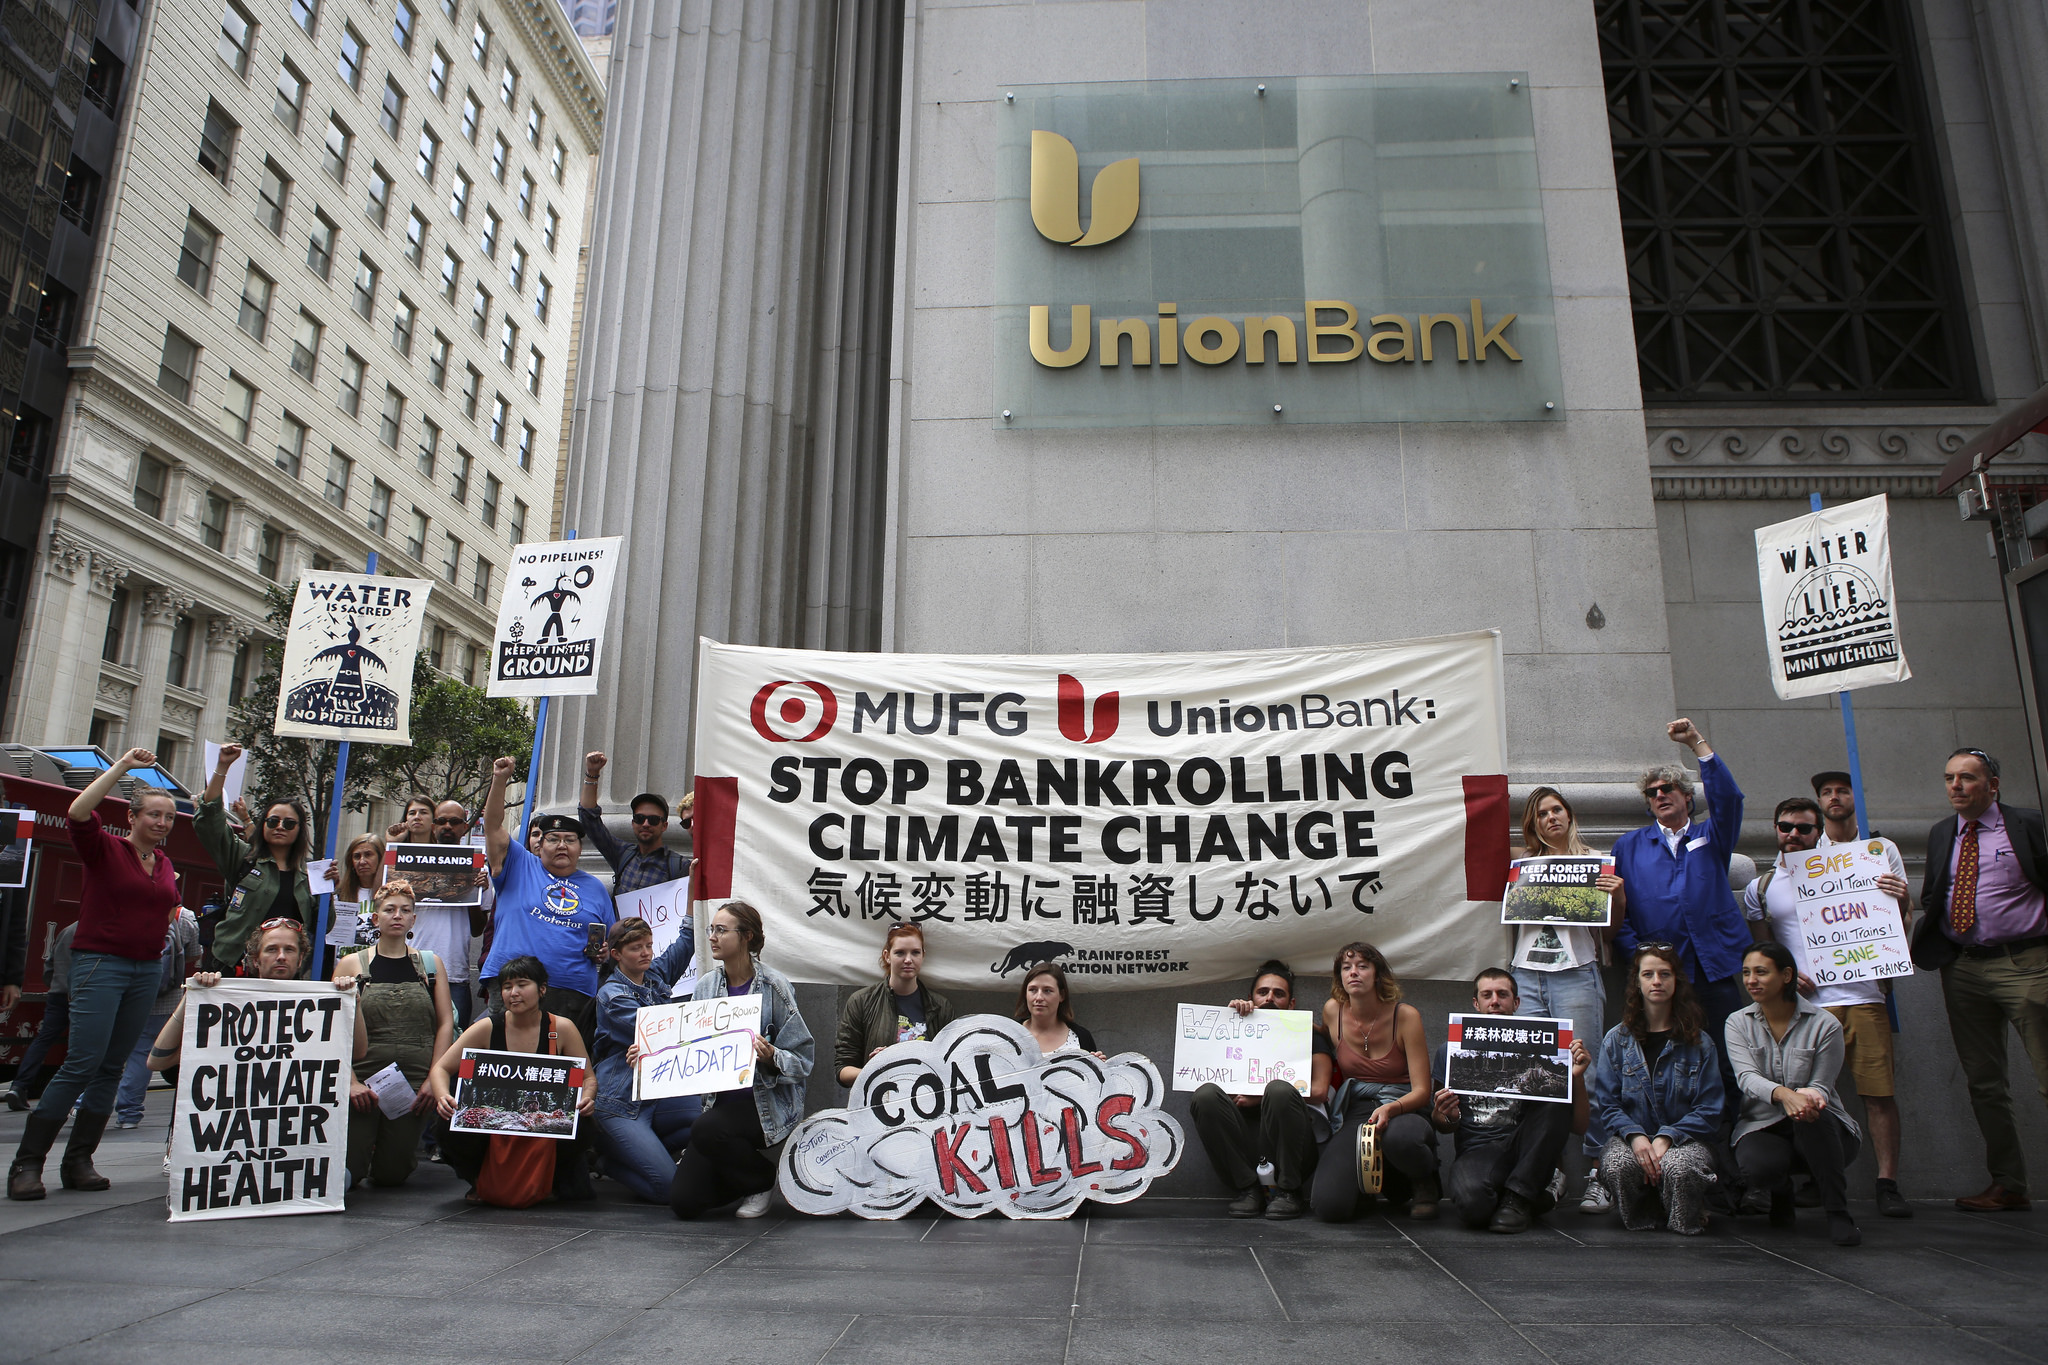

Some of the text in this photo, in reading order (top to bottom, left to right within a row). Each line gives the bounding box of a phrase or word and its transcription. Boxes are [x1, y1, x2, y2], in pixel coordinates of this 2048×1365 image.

[1029, 298, 1523, 367] UnionBank
[518, 550, 604, 564] NO PIPELINES!
[1780, 531, 1868, 574] WATER
[308, 582, 411, 608] WATER
[1803, 580, 1857, 615] LIFE
[326, 602, 392, 616] IS SACRED
[504, 643, 590, 656] KEEP IT IN THE
[502, 655, 590, 676] GROUND
[292, 709, 395, 727] NO PIPELINES!
[852, 691, 1028, 736] MUFG
[767, 751, 1414, 807] STOP BANKROLLING
[808, 810, 1379, 865] CLIMATE CHANGE
[397, 854, 473, 865] NO TAR SANDS
[1519, 864, 1600, 874] KEEP FORESTS
[1805, 852, 1853, 879] SAFE
[1528, 874, 1588, 883] STANDING
[1797, 884, 1816, 899] No
[1820, 878, 1843, 894] Oil
[806, 867, 1384, 925] 気候変動に融資しないで
[530, 907, 583, 928] Protector
[1821, 902, 1869, 925] CLEAN
[1807, 932, 1826, 947] No
[1831, 931, 1848, 943] Oil
[1077, 949, 1170, 961] RAINFOREST
[1832, 944, 1880, 966] SANE
[1061, 961, 1189, 974] ACTION NETWORK
[1816, 969, 1836, 984] NO
[1843, 968, 1867, 981] OIL
[196, 998, 342, 1049] PROTECT
[695, 1016, 713, 1029] THE
[1181, 1007, 1270, 1040] Water
[1464, 1026, 1555, 1045] #森林破壊ゼロ
[234, 1044, 295, 1061] OUR
[191, 1059, 341, 1111] CLIMATE,
[869, 1054, 1027, 1127] COAL
[189, 1105, 330, 1152] WATER
[799, 1132, 829, 1154] STUDY
[932, 1095, 1151, 1196] KILLS
[221, 1147, 288, 1163] AND
[182, 1157, 330, 1212] HEALTH
